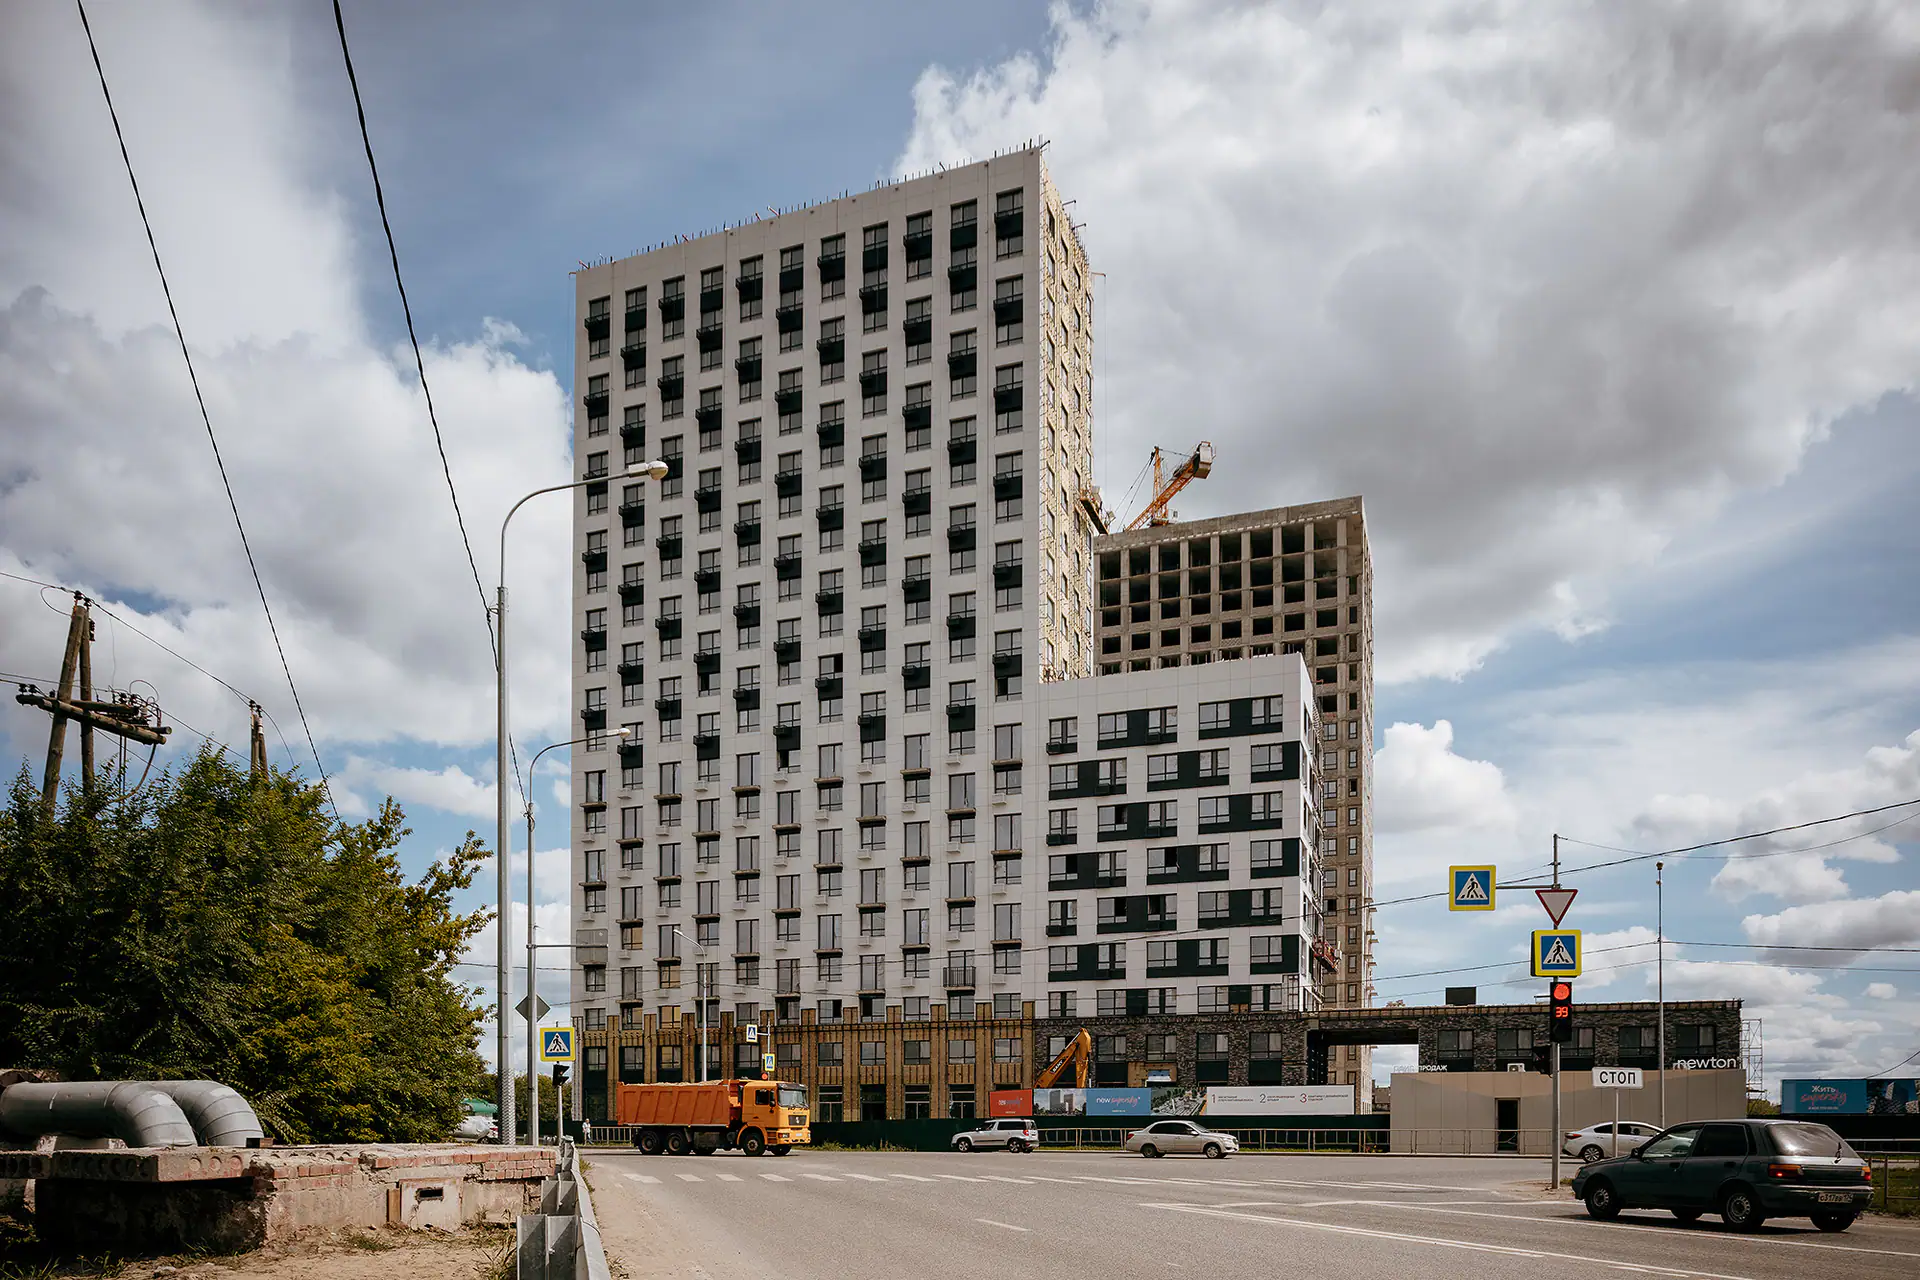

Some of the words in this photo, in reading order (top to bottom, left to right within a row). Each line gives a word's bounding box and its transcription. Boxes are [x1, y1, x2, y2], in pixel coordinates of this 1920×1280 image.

[1556, 1007, 1568, 1017] 39
[1677, 1057, 1737, 1068] newton
[1418, 1064, 1448, 1072] ПРОДАЖ
[1600, 1071, 1636, 1084] СТОП
[1259, 1093, 1267, 1103] 2
[1299, 1093, 1307, 1103] 3
